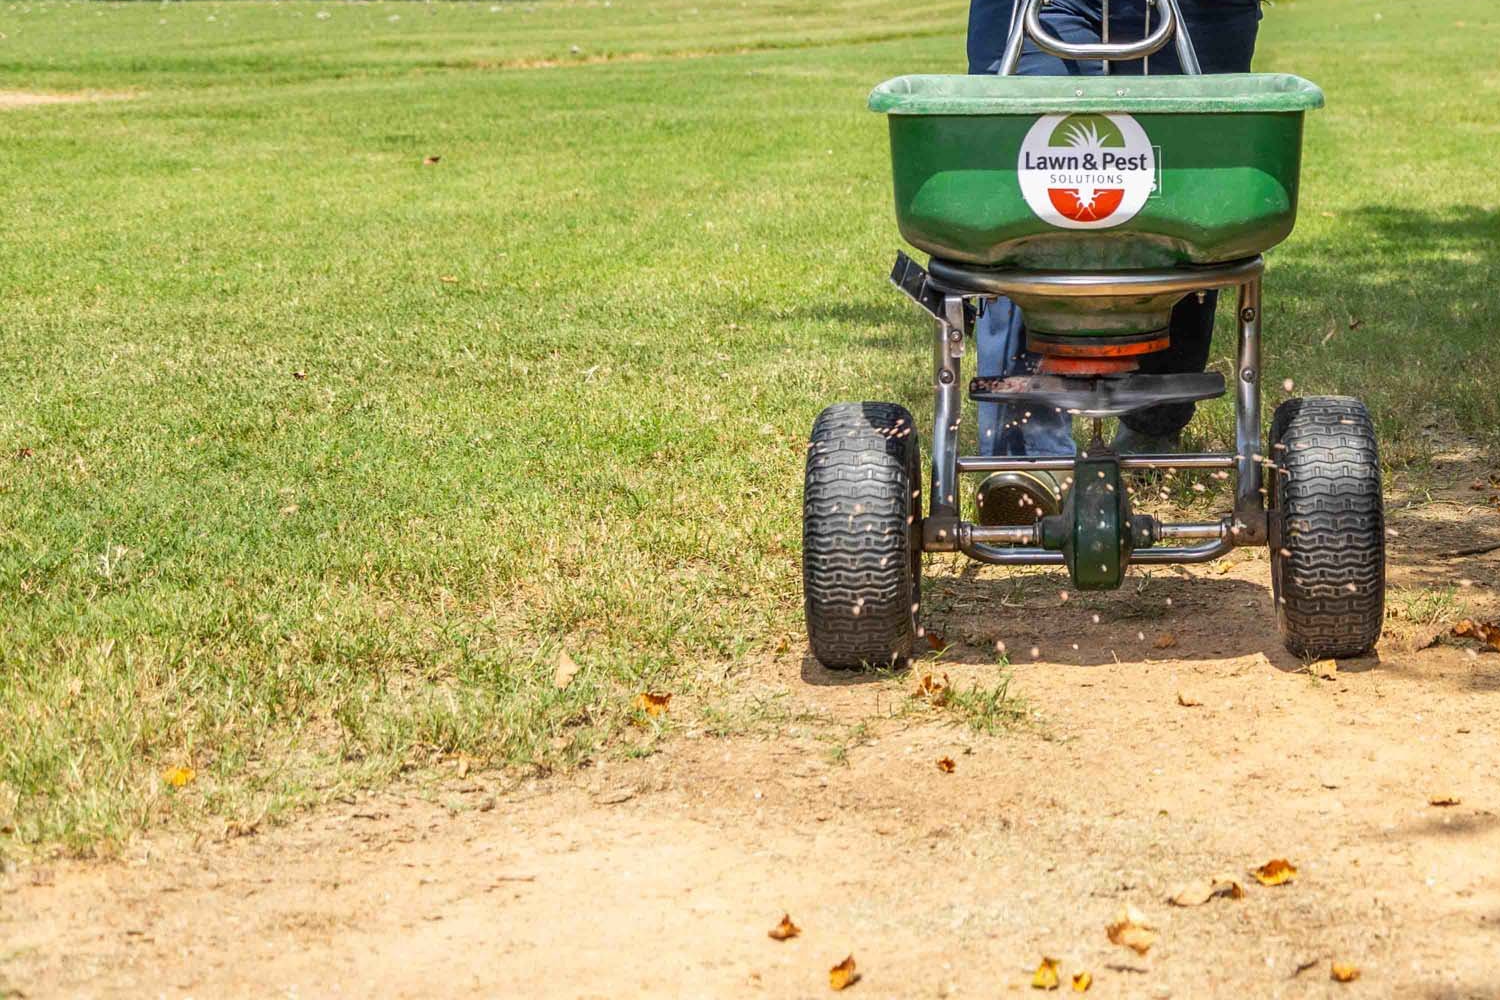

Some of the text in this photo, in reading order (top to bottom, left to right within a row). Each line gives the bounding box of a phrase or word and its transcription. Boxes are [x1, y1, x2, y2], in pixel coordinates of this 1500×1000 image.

[1025, 151, 1147, 171] Lawn & Pest
[1050, 174, 1124, 184] SOLUTIONS
